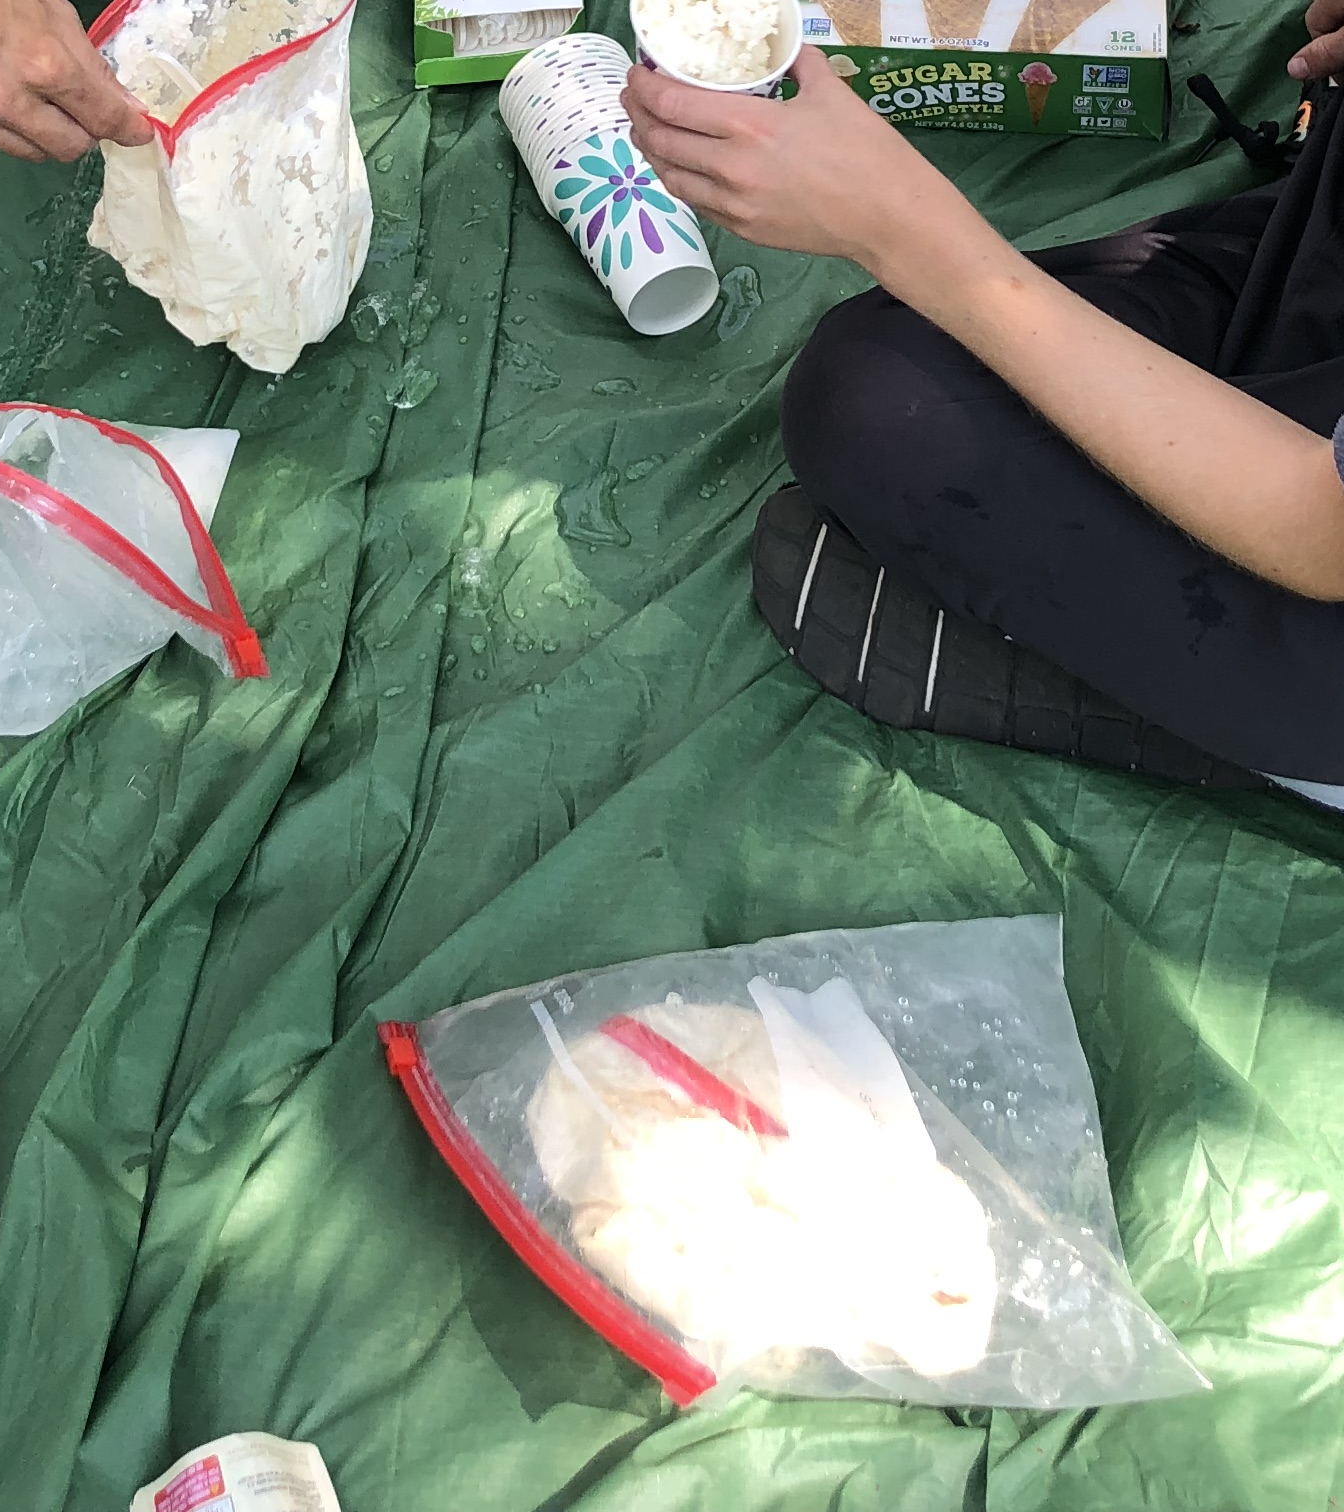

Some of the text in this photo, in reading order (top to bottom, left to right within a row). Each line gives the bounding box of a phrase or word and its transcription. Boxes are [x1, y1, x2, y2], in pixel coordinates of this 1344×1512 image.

[889, 35, 909, 43] NET
[911, 36, 928, 45] WT
[1110, 31, 1135, 43] 12
[869, 62, 993, 93] SUGAR
[869, 82, 1005, 114] CONES
[1075, 97, 1091, 106] GF
[949, 104, 1004, 114] STYLE
